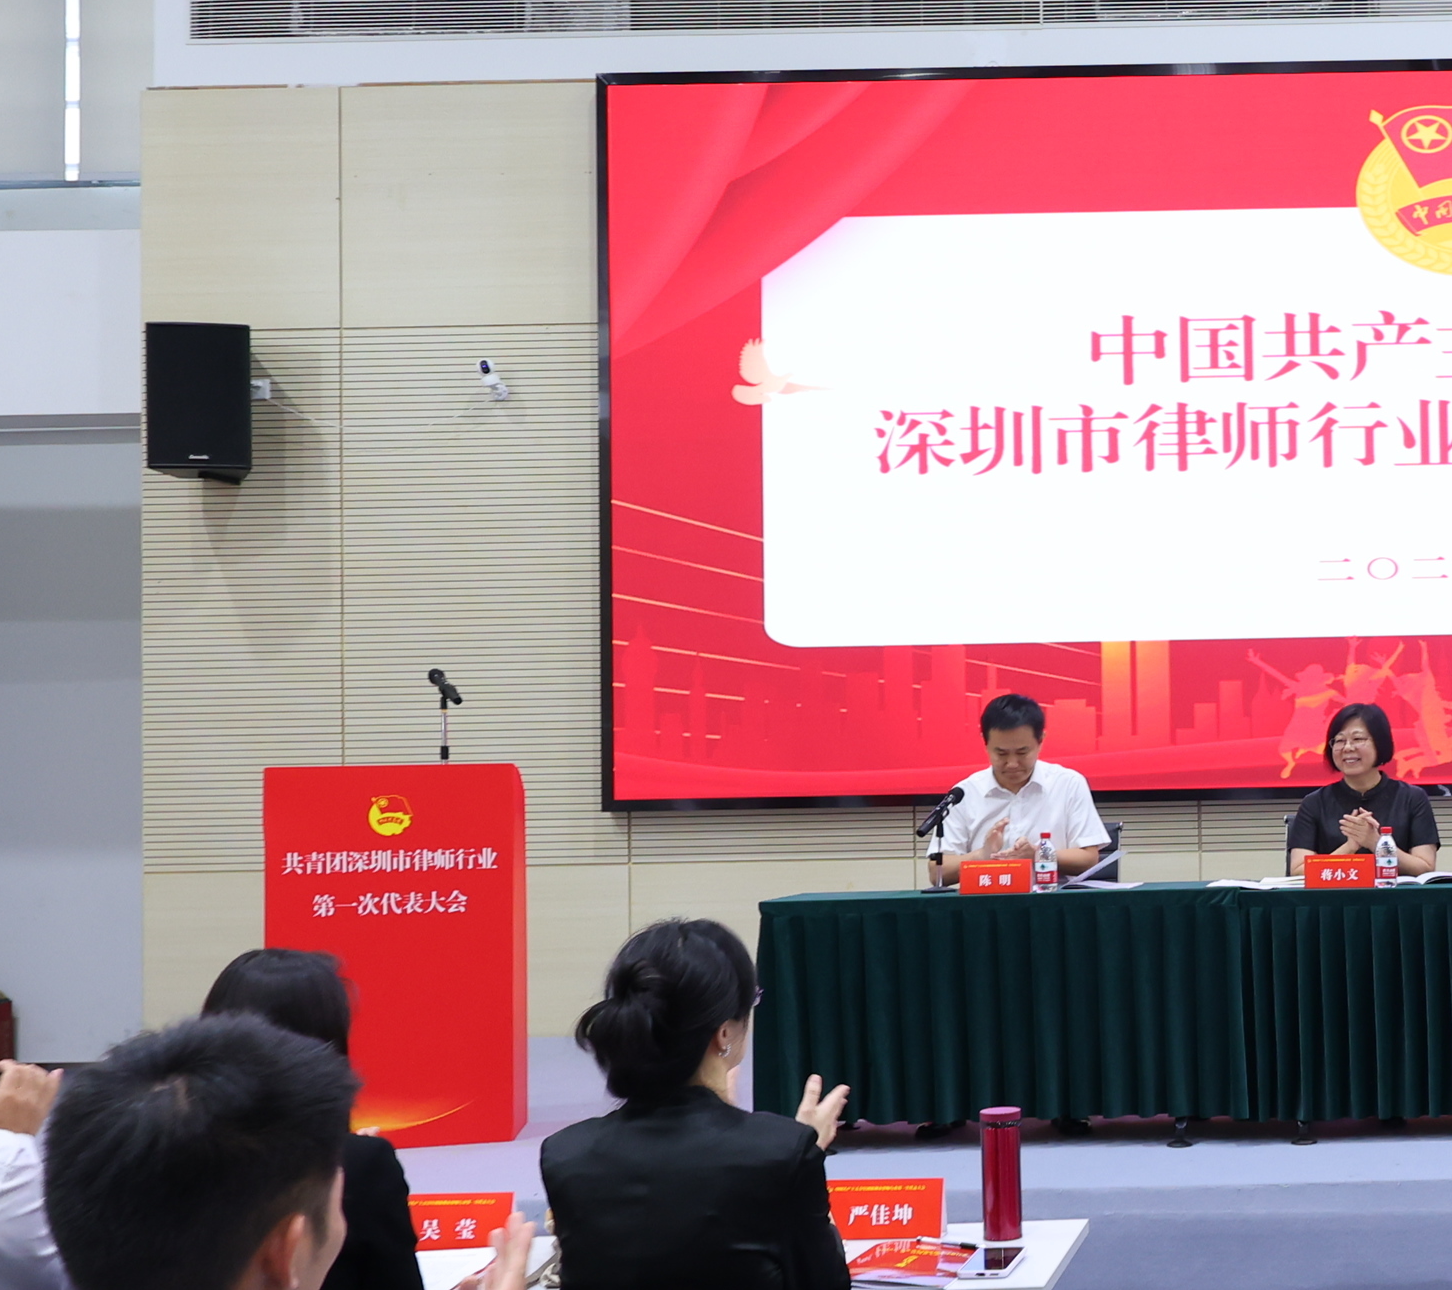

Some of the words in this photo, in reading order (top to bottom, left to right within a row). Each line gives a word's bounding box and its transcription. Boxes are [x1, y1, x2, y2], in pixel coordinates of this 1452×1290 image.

[282, 847, 498, 875] 共青团深圳市律师行业
[312, 890, 468, 918] 第一次代表大会
[848, 1203, 914, 1226] 严佳坤
